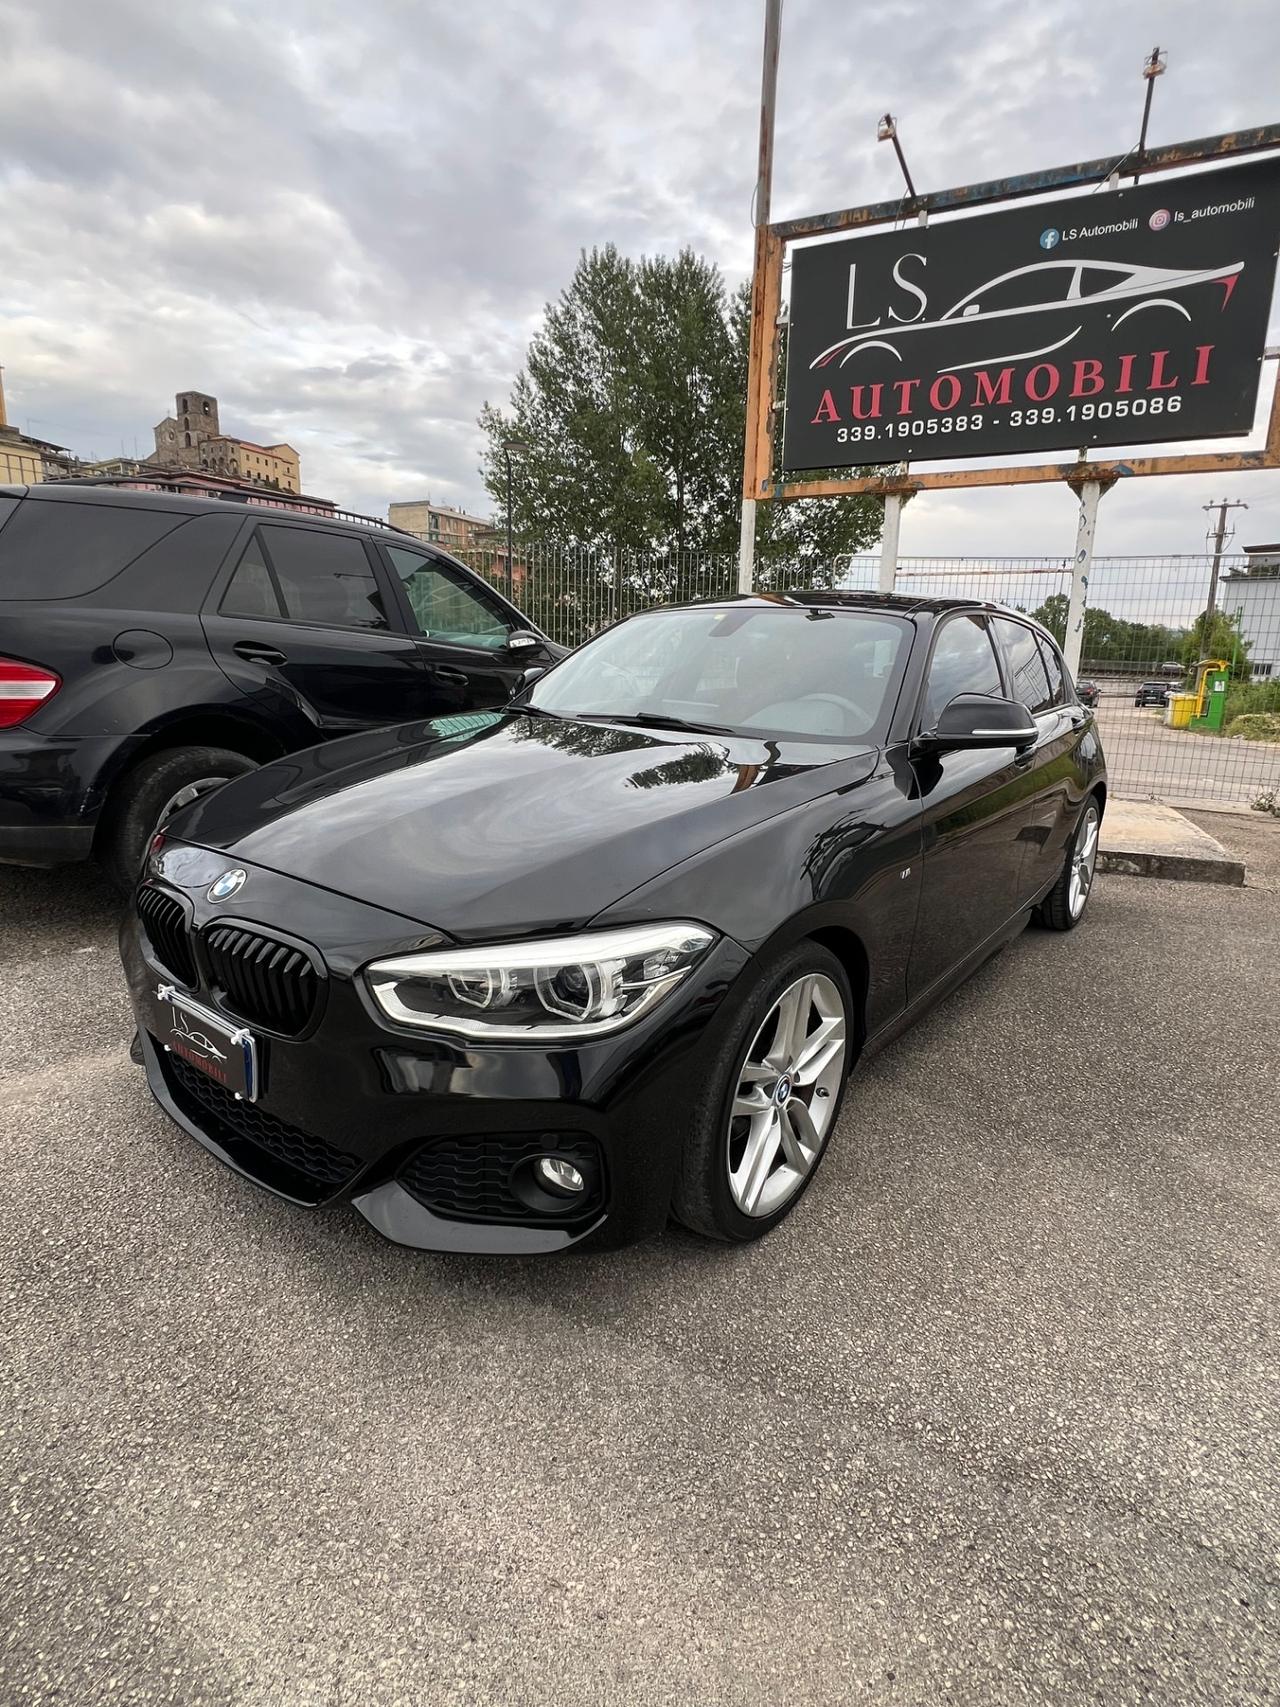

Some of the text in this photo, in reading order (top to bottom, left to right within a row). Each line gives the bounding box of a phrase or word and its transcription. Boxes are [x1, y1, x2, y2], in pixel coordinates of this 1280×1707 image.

[1174, 197, 1255, 223] ls_automobili
[1062, 218, 1139, 241] LS Automobili
[811, 345, 1215, 424] AUTOMOBILI
[837, 415, 984, 443] 339.1905383
[1010, 395, 1183, 427] 339.1905086
